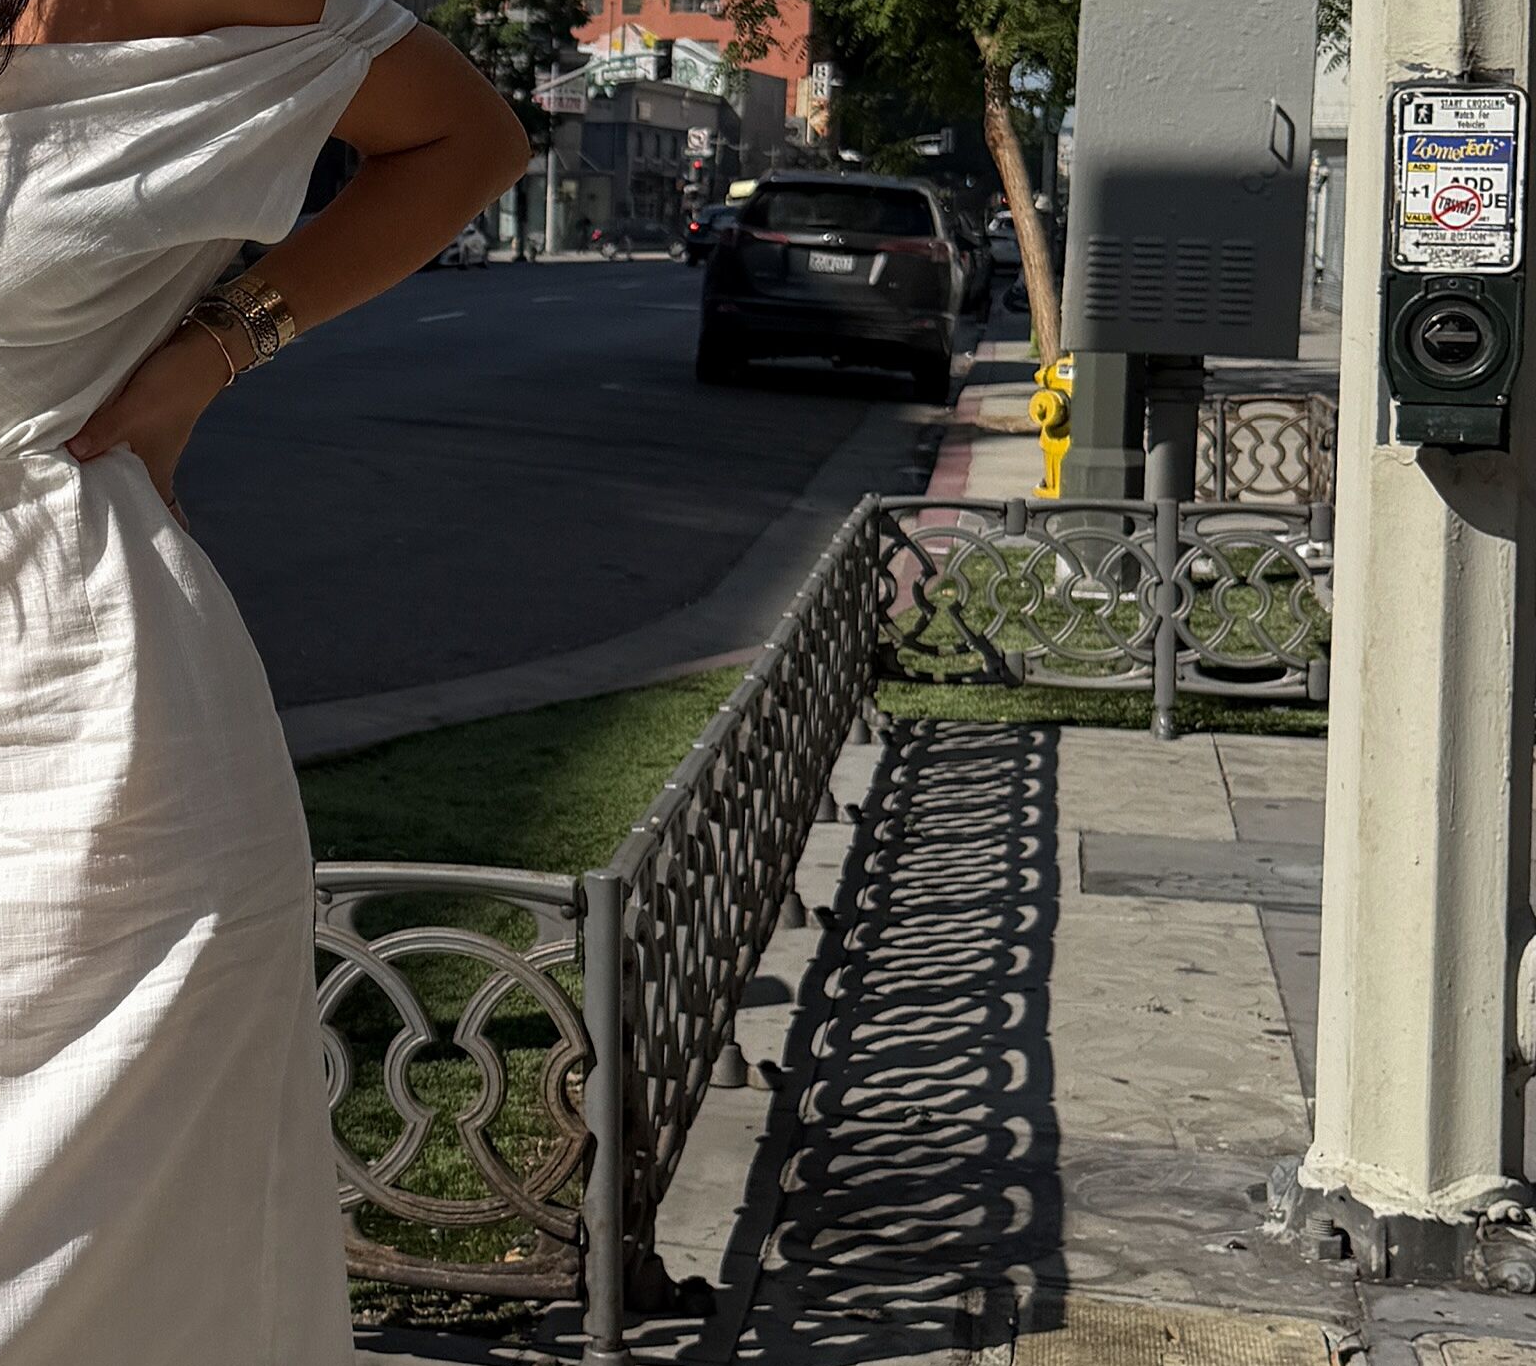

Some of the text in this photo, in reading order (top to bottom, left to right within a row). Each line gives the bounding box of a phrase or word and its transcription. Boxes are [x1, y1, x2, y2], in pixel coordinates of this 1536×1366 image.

[1440, 99, 1505, 109] START CROSSING
[1412, 137, 1495, 161] ZoomerTech
[1409, 184, 1429, 198] +1
[1438, 196, 1476, 216] TRUMP
